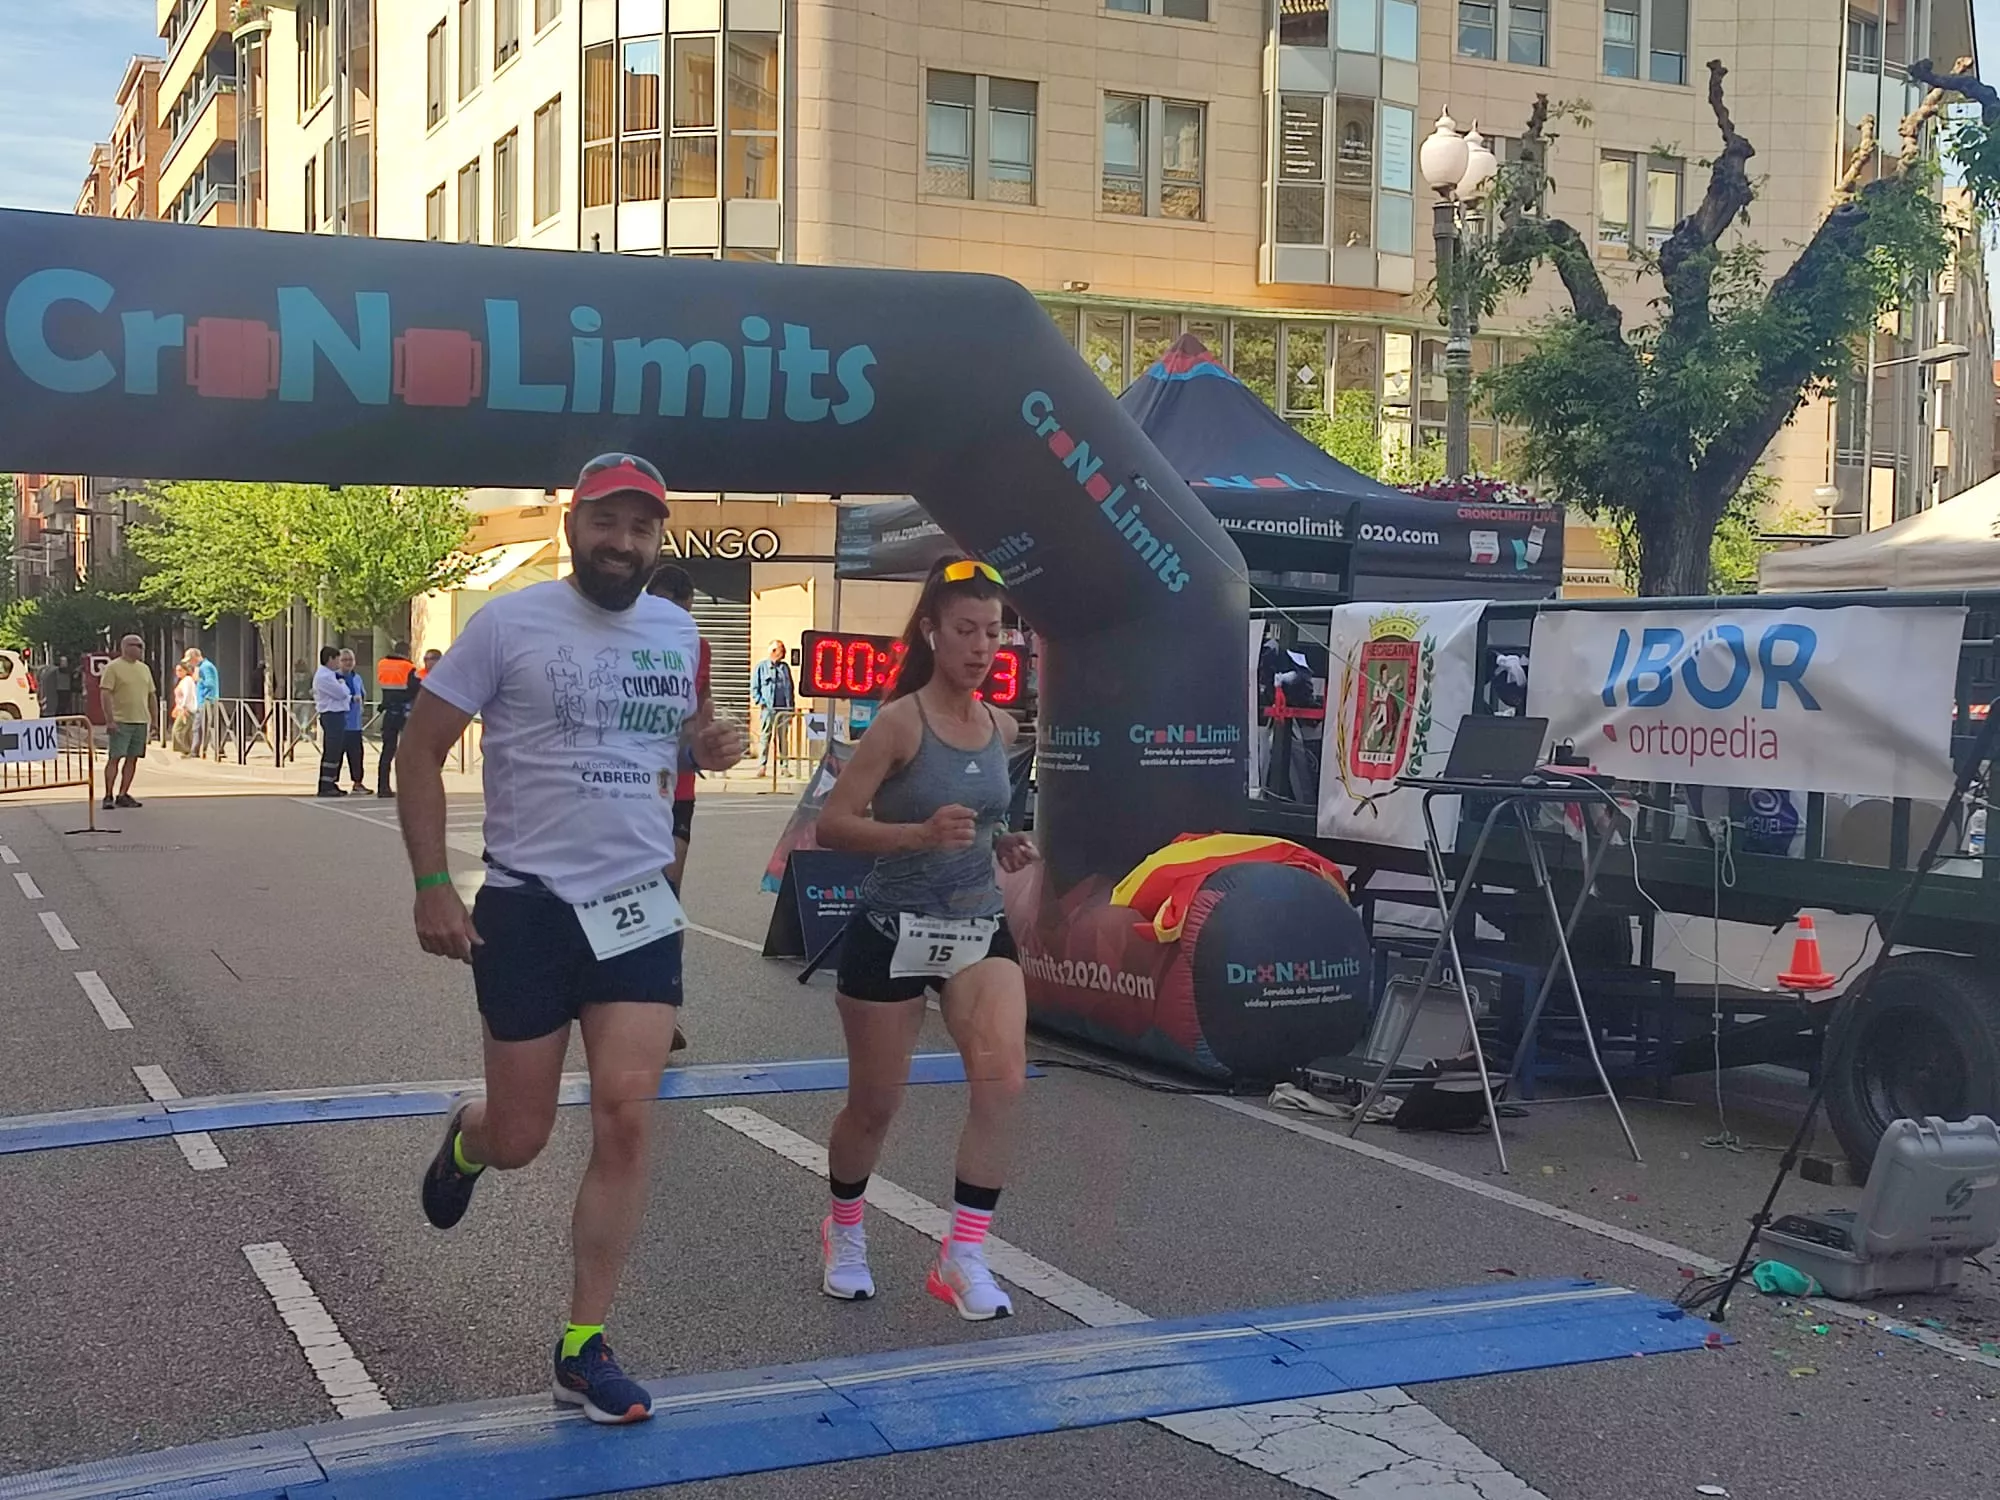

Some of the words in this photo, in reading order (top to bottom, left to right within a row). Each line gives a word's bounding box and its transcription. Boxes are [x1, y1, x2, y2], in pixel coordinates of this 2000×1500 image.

[660, 527, 780, 560] ANGO
[1600, 623, 1823, 711] IBOR
[622, 675, 680, 698] CIUDAD
[681, 676, 693, 700] D
[22, 724, 57, 752] 10K
[1629, 715, 1779, 768] ortopedia
[581, 771, 651, 784] CABRERO
[611, 902, 646, 931] 25
[927, 945, 955, 962] 15
[1018, 945, 1157, 1001] limits2020.com
